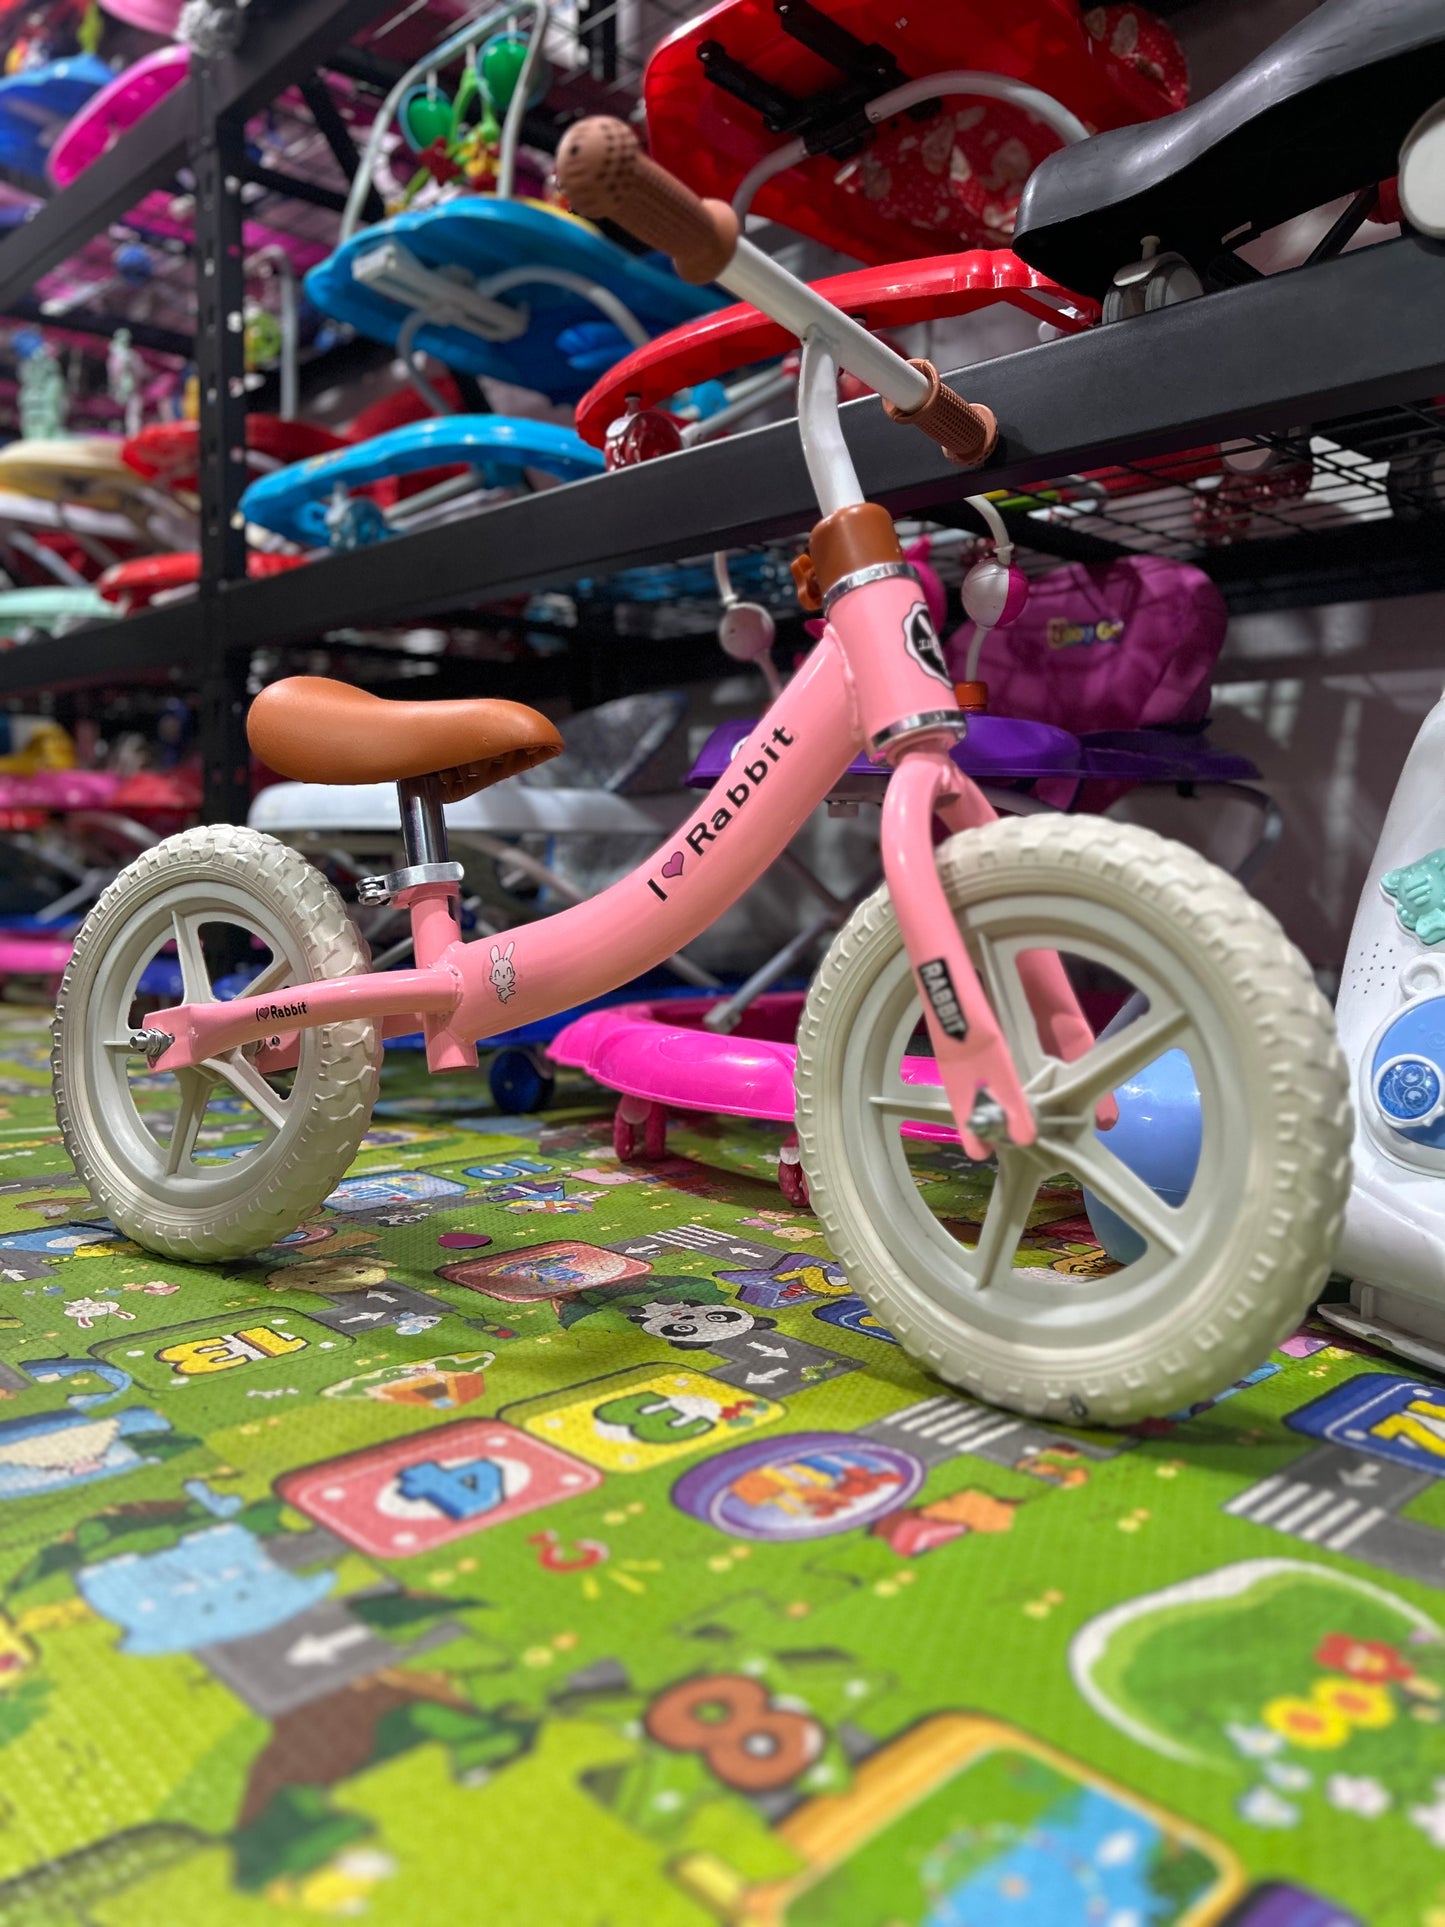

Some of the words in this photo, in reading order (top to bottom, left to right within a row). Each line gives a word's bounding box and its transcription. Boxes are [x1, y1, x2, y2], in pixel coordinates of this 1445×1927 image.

[647, 878, 669, 902] I
[685, 726, 795, 857] Rabbit
[270, 1001, 307, 1019] Rabbit
[920, 961, 967, 1035] RABBIT
[153, 1325, 312, 1376] 13
[592, 1390, 717, 1445] 3
[395, 1456, 507, 1521] 4
[643, 1671, 827, 1793] 8
